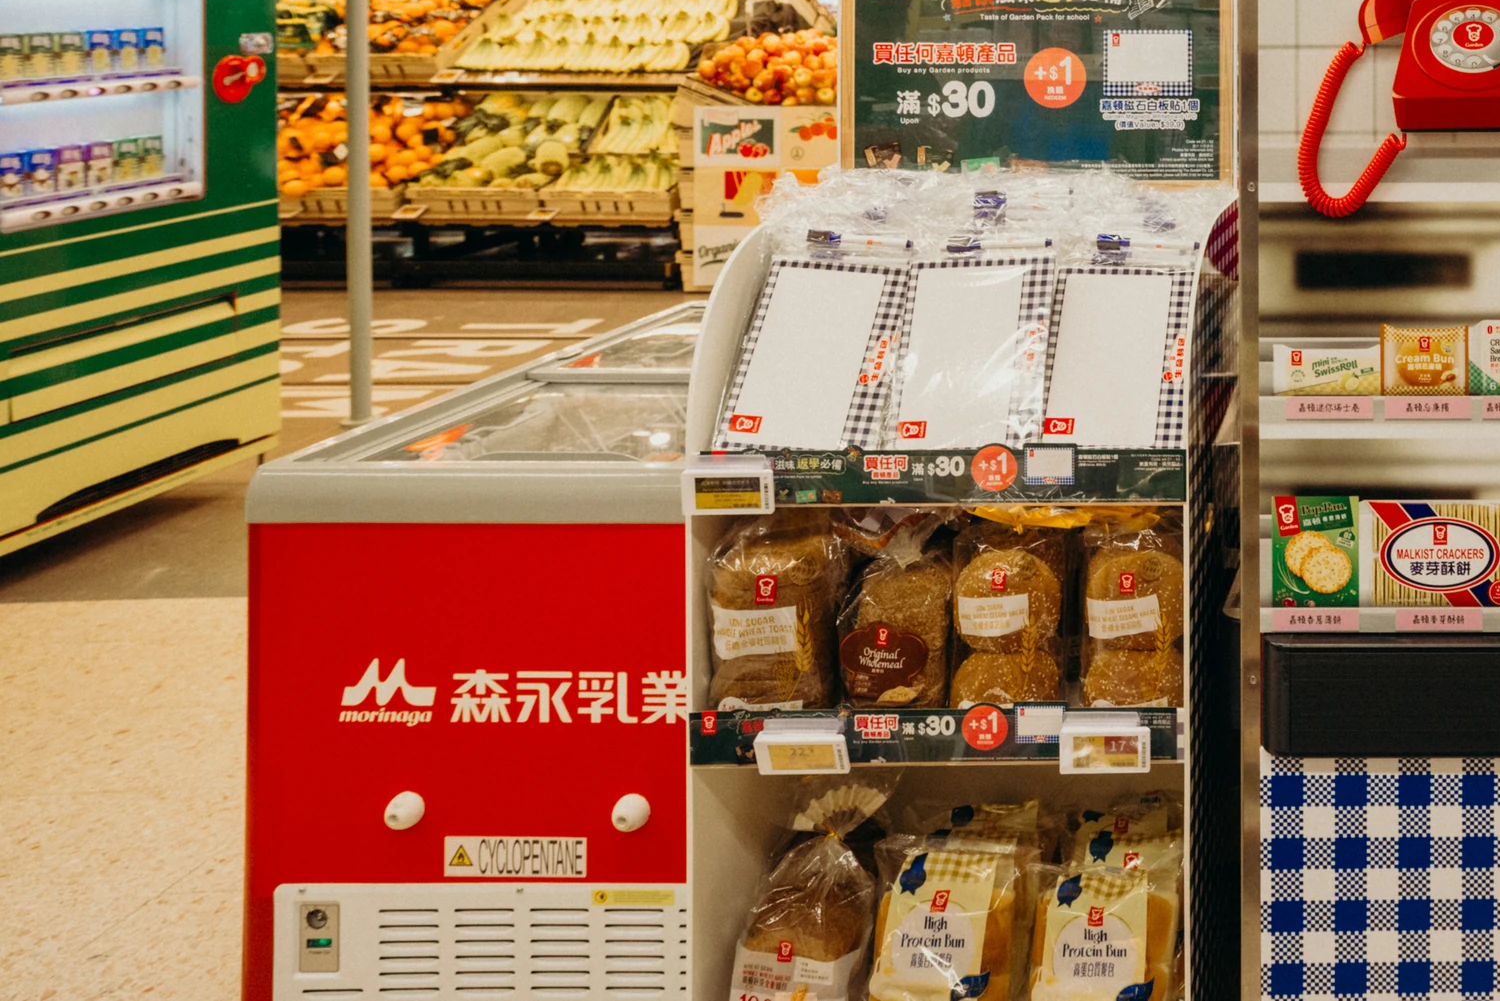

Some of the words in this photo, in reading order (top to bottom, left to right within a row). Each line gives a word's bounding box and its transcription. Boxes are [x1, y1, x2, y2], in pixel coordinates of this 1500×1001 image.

[980, 13, 999, 21] Taste
[1000, 13, 1008, 21] of
[1009, 13, 1035, 21] Garden
[1036, 13, 1054, 21] Pack
[1055, 13, 1065, 21] for
[1066, 13, 1090, 21] school
[872, 42, 1017, 64] 買任何嘉頓產品
[897, 67, 911, 75] Buy
[957, 67, 990, 75] products
[896, 90, 921, 115] 滿
[927, 80, 996, 118] $30
[900, 117, 919, 125] Upon
[698, 238, 741, 259] Organi
[1312, 357, 1330, 371] mini
[1395, 354, 1431, 364] Cream
[1433, 353, 1455, 364] Bun
[1314, 360, 1358, 378] SwissRoll
[1489, 382, 1497, 391] 6
[865, 455, 908, 471] 買任何
[912, 463, 924, 476] 滿
[927, 455, 965, 477] $30
[1279, 524, 1299, 532] Garden
[1396, 548, 1435, 560] MALKIST
[1436, 548, 1485, 560] CRACKERS
[1409, 561, 1471, 576] 麥芽酥餅
[745, 615, 776, 627] SUGAR
[738, 626, 766, 638] WHEAT
[769, 624, 793, 633] TOAST
[863, 646, 901, 661] Original
[859, 655, 906, 669] Wholemeal
[449, 669, 688, 725] 森永乳業
[338, 706, 433, 727] morinaga
[854, 714, 899, 731] 買任何
[902, 722, 916, 735] 滿
[918, 715, 956, 737] $30
[478, 838, 583, 876] CYCLOPENTANE
[923, 915, 948, 932] High
[900, 933, 942, 949] Protein
[944, 933, 965, 949] Bun
[1083, 928, 1108, 944] High
[1062, 943, 1103, 958] Protein
[1105, 944, 1127, 958] Bun
